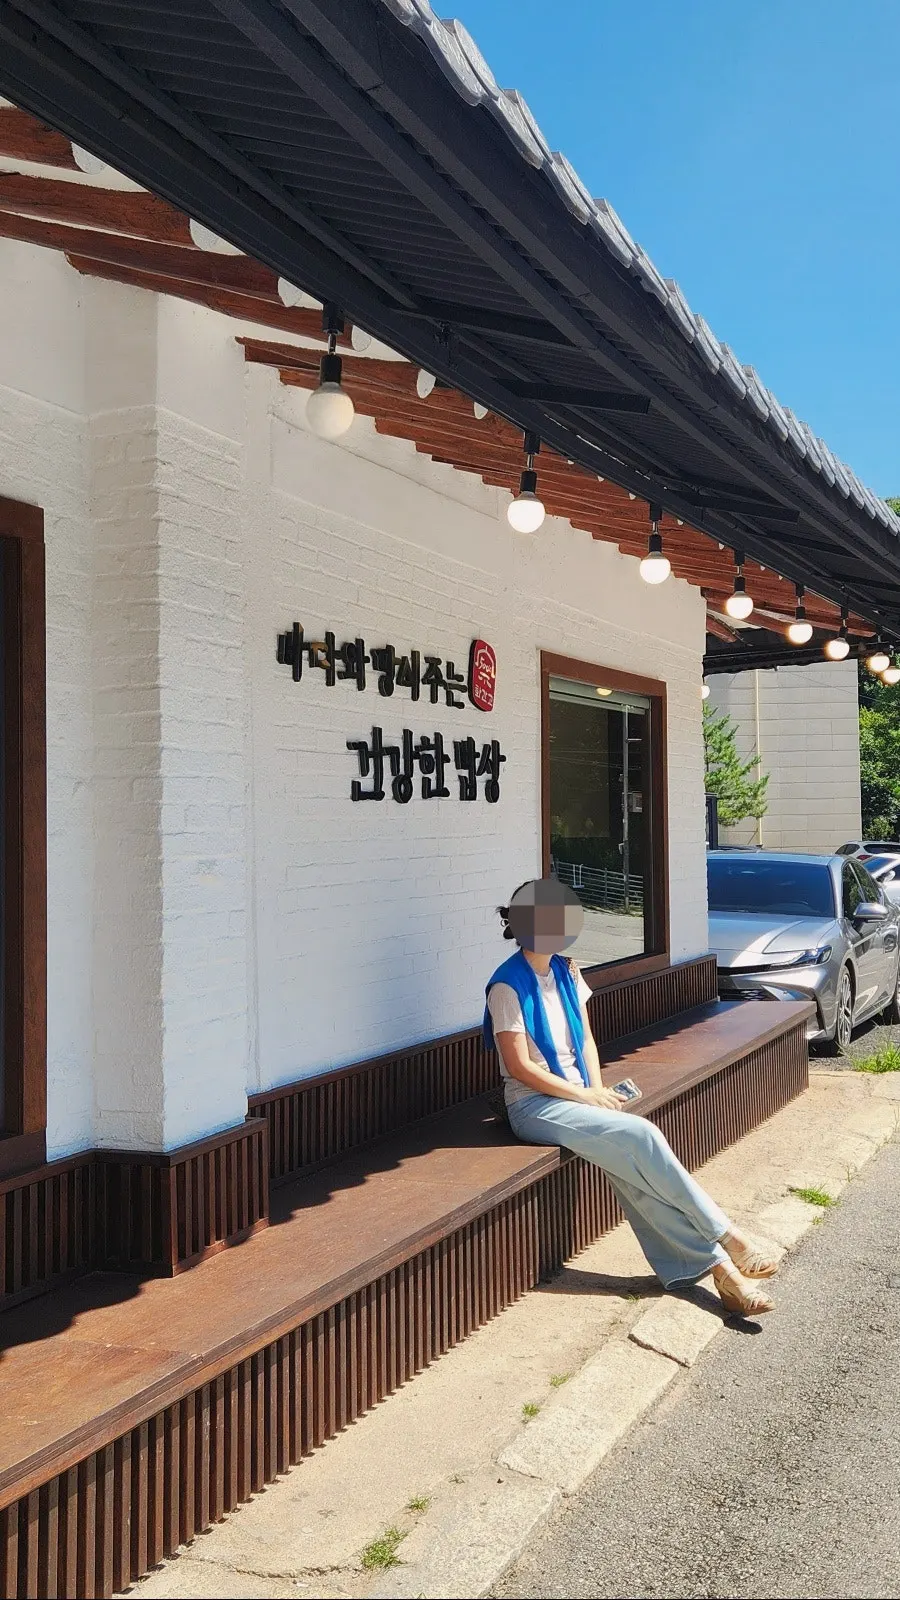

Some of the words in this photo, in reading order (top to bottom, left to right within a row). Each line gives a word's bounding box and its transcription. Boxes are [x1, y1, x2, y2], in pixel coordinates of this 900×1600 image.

[276, 621, 370, 691] 바다와
[370, 645, 420, 701] 땅이
[421, 656, 468, 709] 주는
[346, 726, 450, 803] 건강한
[453, 736, 507, 803] 밥상
